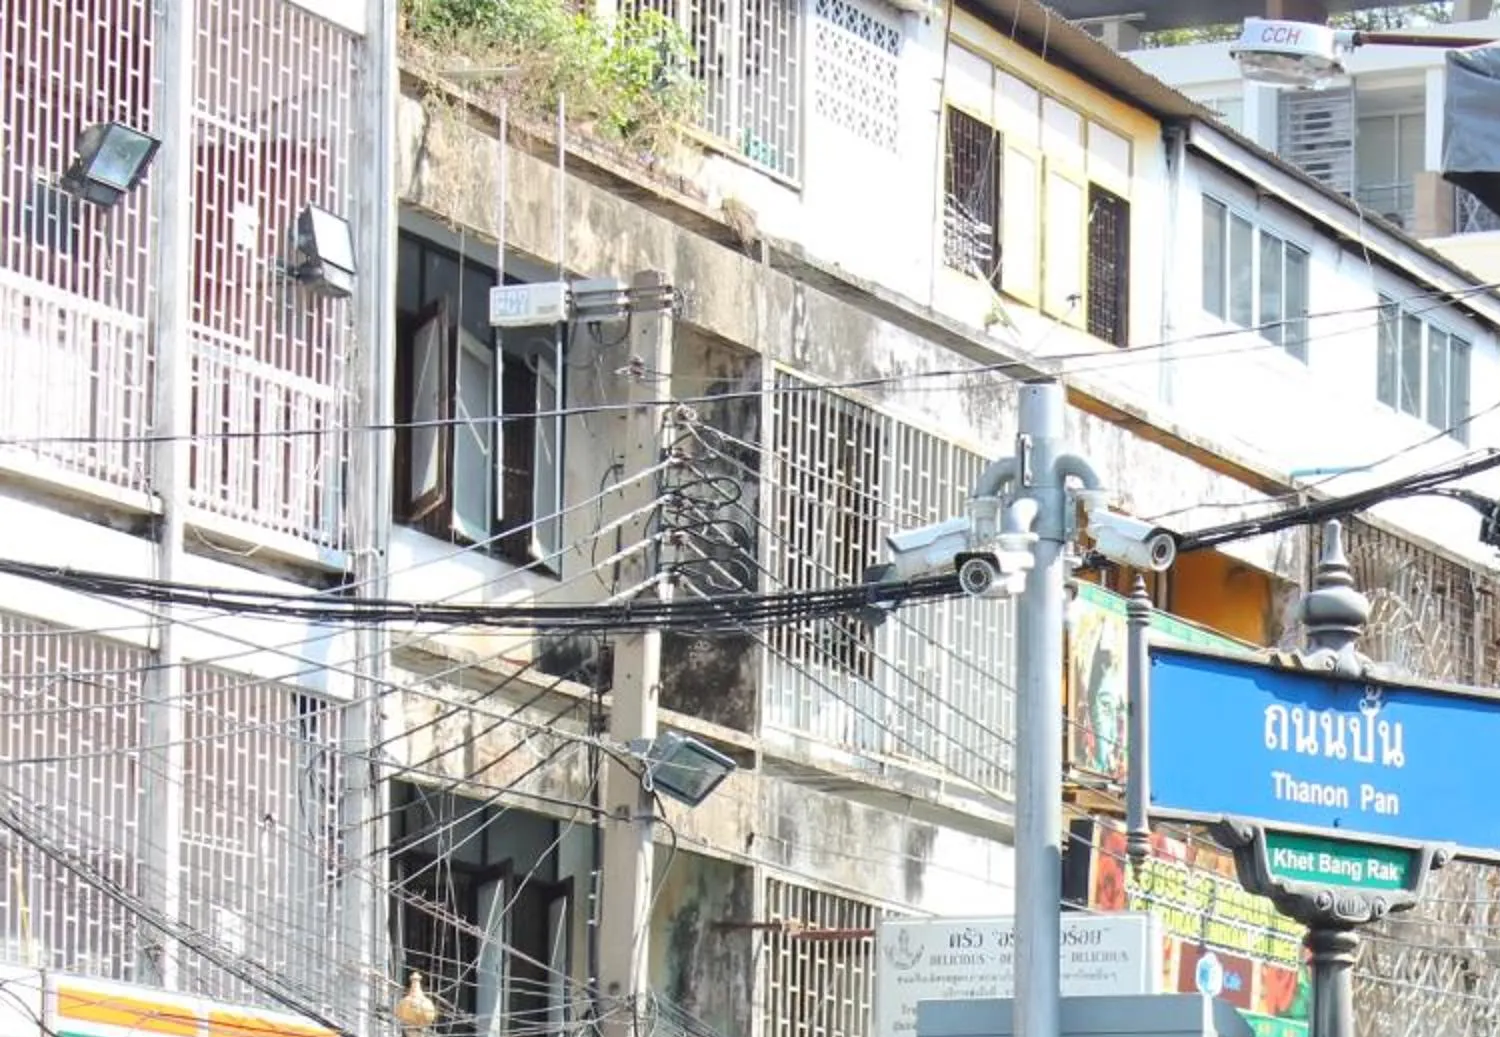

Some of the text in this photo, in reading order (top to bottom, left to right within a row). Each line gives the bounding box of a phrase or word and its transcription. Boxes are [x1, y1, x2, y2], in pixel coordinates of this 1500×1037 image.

[1263, 685, 1406, 769] ถนนปั้น
[1271, 770, 1399, 816] Thanon Pan
[1273, 847, 1400, 881] Khet Bang Rak
[929, 953, 986, 968] DELICIOUS
[1070, 949, 1129, 964] DELICIOUS
